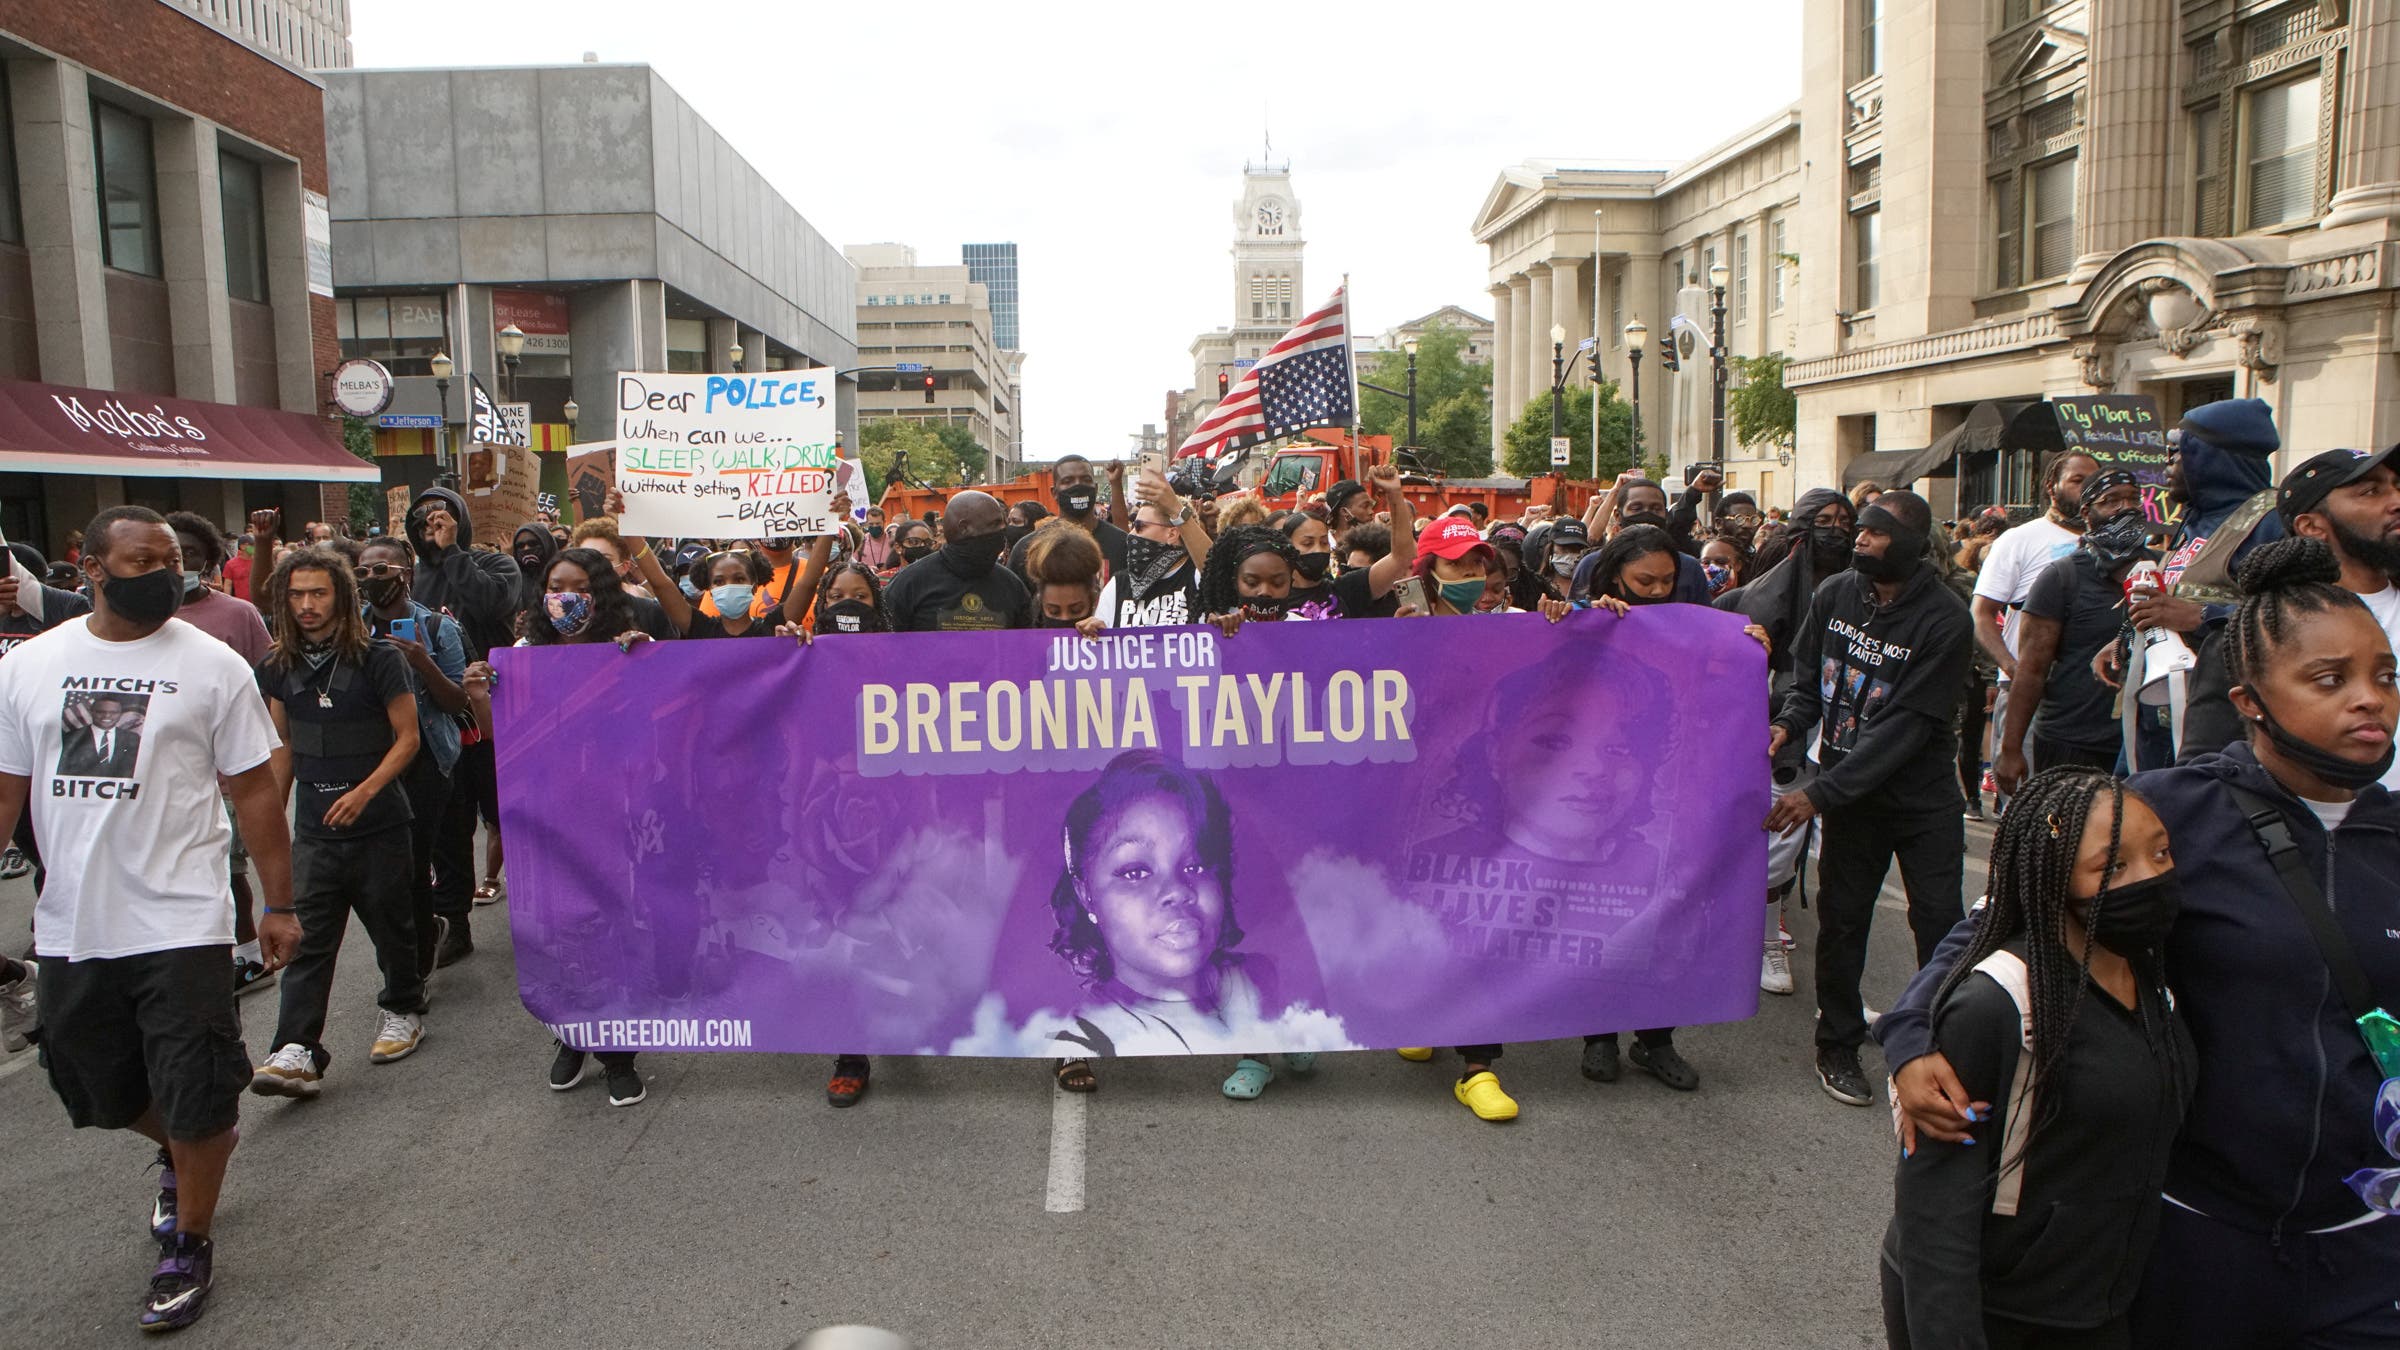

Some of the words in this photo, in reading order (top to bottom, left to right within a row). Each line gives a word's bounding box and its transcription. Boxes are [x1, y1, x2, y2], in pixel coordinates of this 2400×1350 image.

[496, 307, 509, 316] or
[511, 306, 540, 318] Lease
[526, 337, 544, 348] 426
[547, 338, 569, 349] 1300
[340, 381, 380, 390] MELBA'S
[620, 377, 695, 413] Dear
[705, 376, 825, 414] POLICE,
[51, 395, 206, 440] Melba's
[394, 416, 432, 426] Jefferson
[501, 407, 525, 417] ONE
[2058, 403, 2091, 429] My
[2091, 404, 2134, 424] Mom
[2135, 406, 2152, 423] is
[623, 418, 678, 443] When
[687, 429, 725, 445] can
[735, 432, 792, 444] we...
[624, 447, 704, 474] SLEEP,
[713, 446, 780, 469] WALK,
[783, 443, 836, 469] DRIVE
[2070, 446, 2114, 462] lice
[694, 479, 741, 500] getting
[747, 469, 834, 497] KILLED?
[764, 518, 826, 537] PEOPLE
[838, 622, 860, 632] TAYLOR
[1050, 635, 1156, 672] JUSTICE
[1163, 632, 1216, 668] FOR
[1882, 641, 1911, 662] MOST
[61, 675, 178, 695] MITCH'S
[861, 676, 1158, 755] BREONNA
[1176, 668, 1411, 748] TAYLOR
[51, 779, 140, 800] BITCH
[1406, 851, 1532, 893] BLACK
[1600, 883, 1649, 897] TAYLOR
[1430, 888, 1558, 927] LIVES
[2386, 928, 2400, 939] UN
[545, 1018, 752, 1048] NTILFREEDOM.COM
